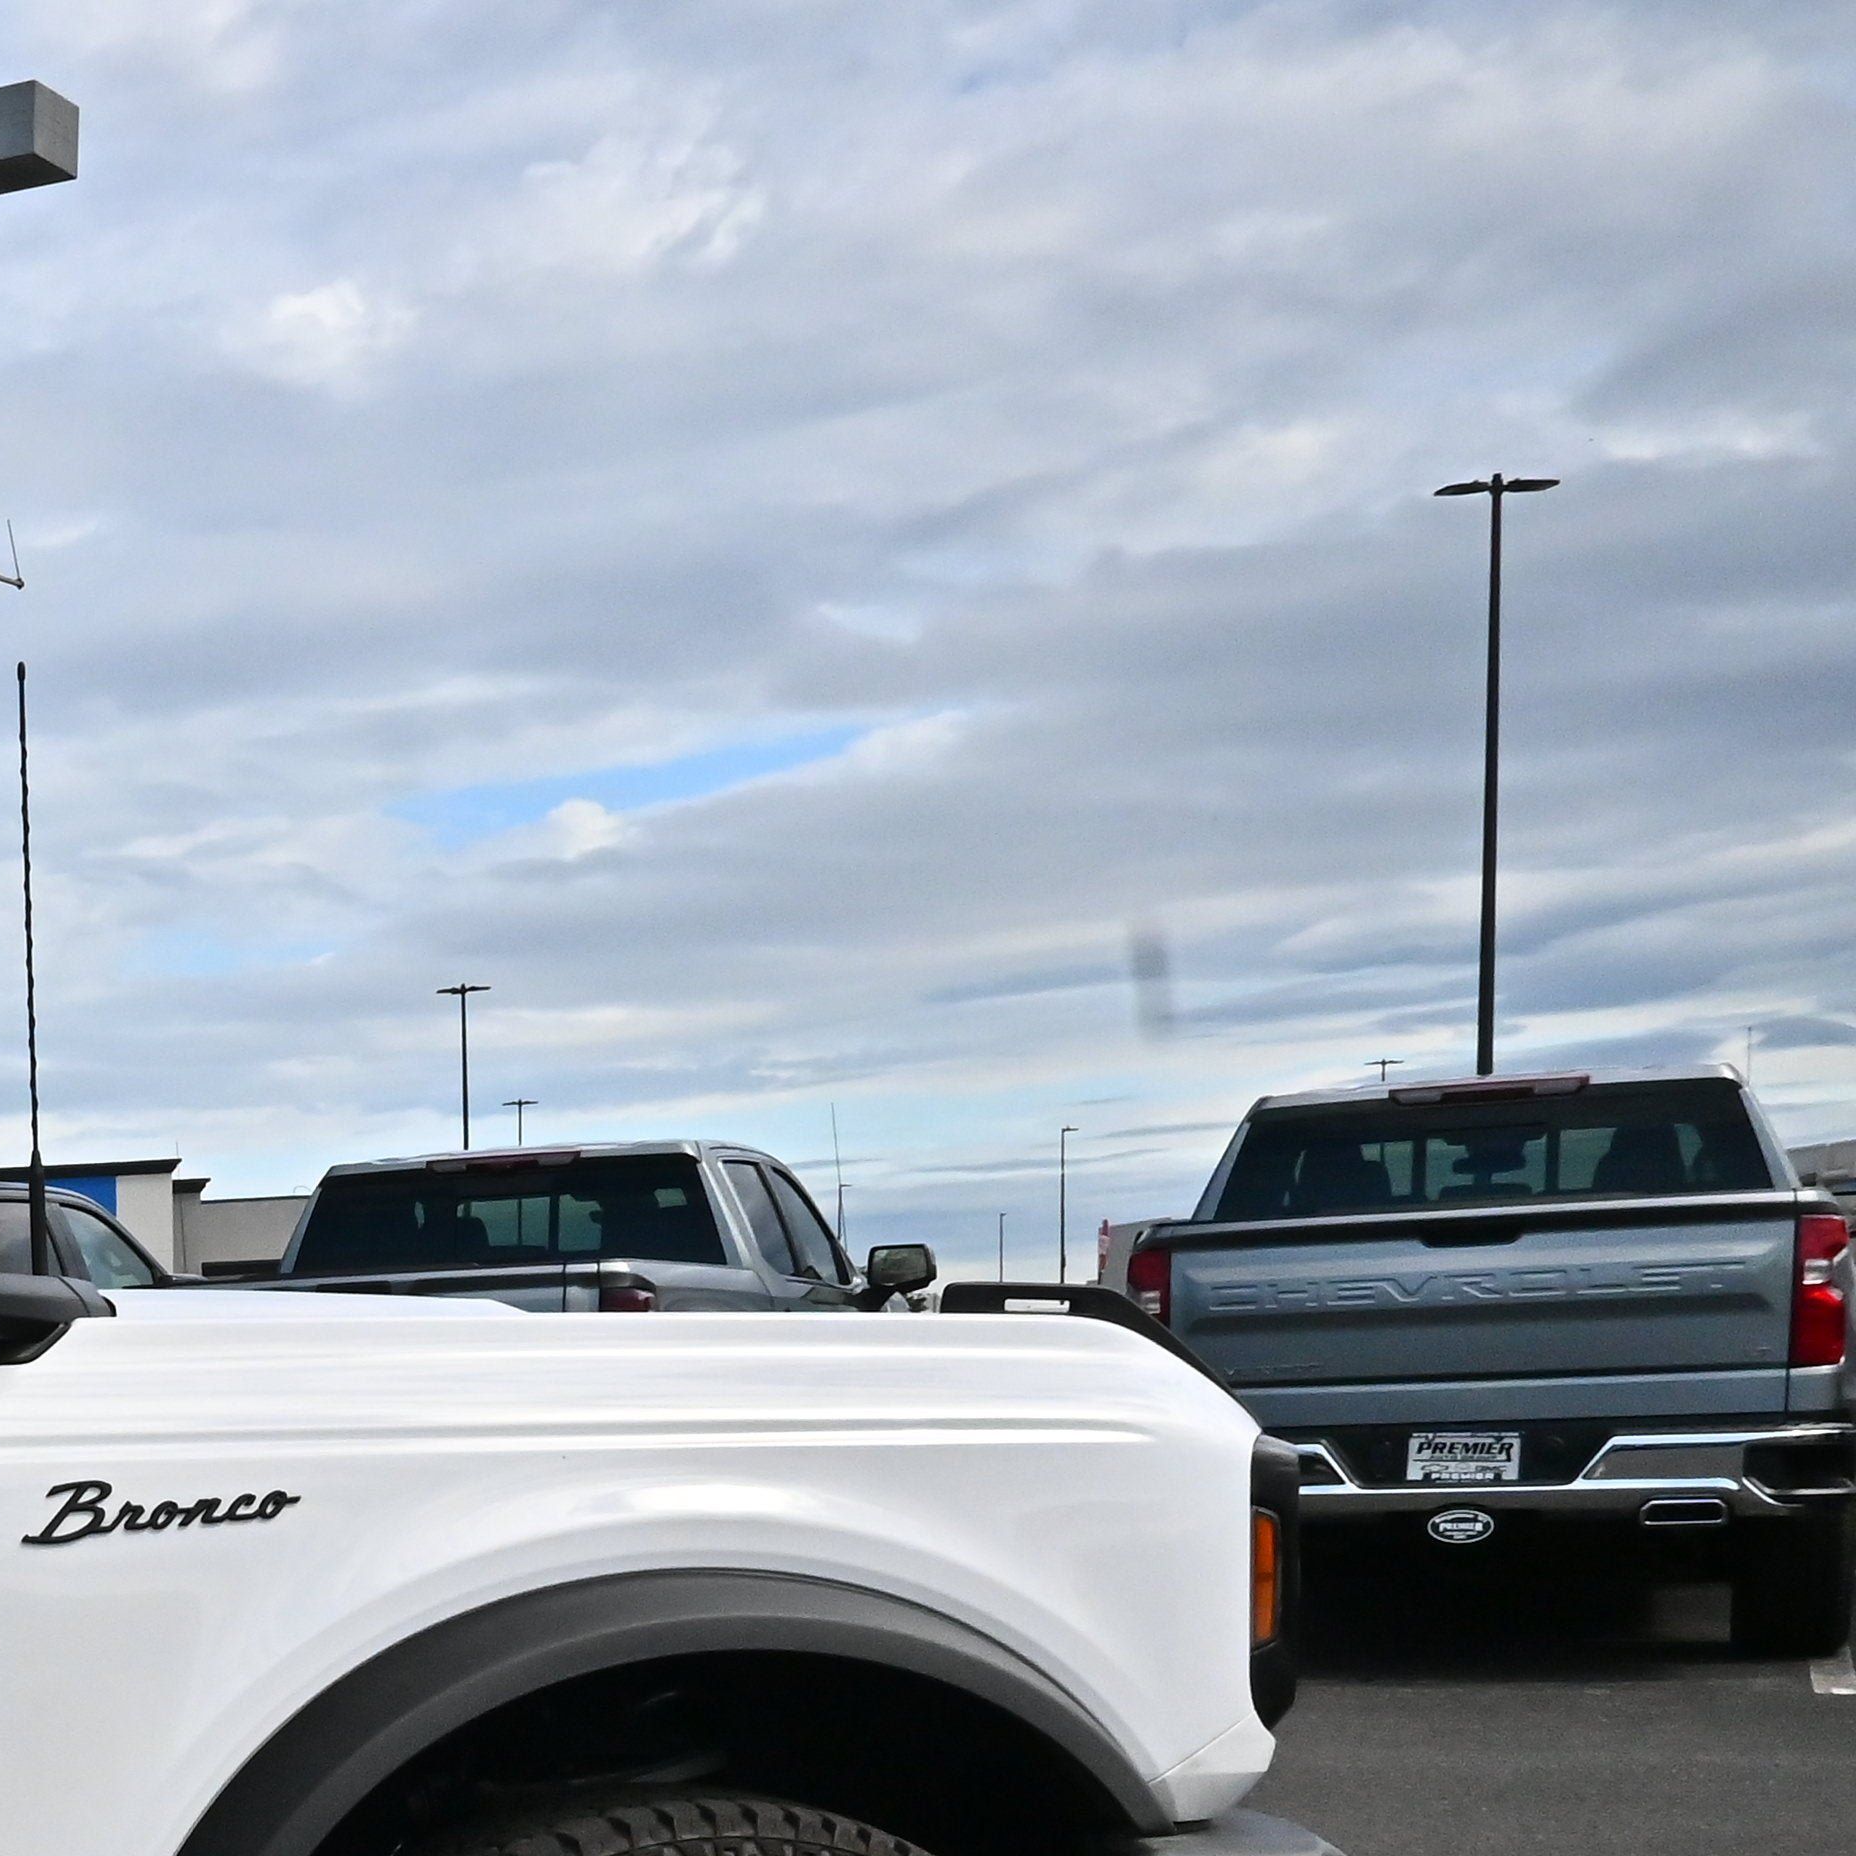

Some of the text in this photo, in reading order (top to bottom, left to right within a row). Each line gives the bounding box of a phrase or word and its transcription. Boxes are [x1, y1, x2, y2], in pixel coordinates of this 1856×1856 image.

[1209, 1261, 1746, 1310] CHEVROLET
[1416, 1442, 1514, 1462] PREMIER
[21, 1479, 302, 1544] Bronco
